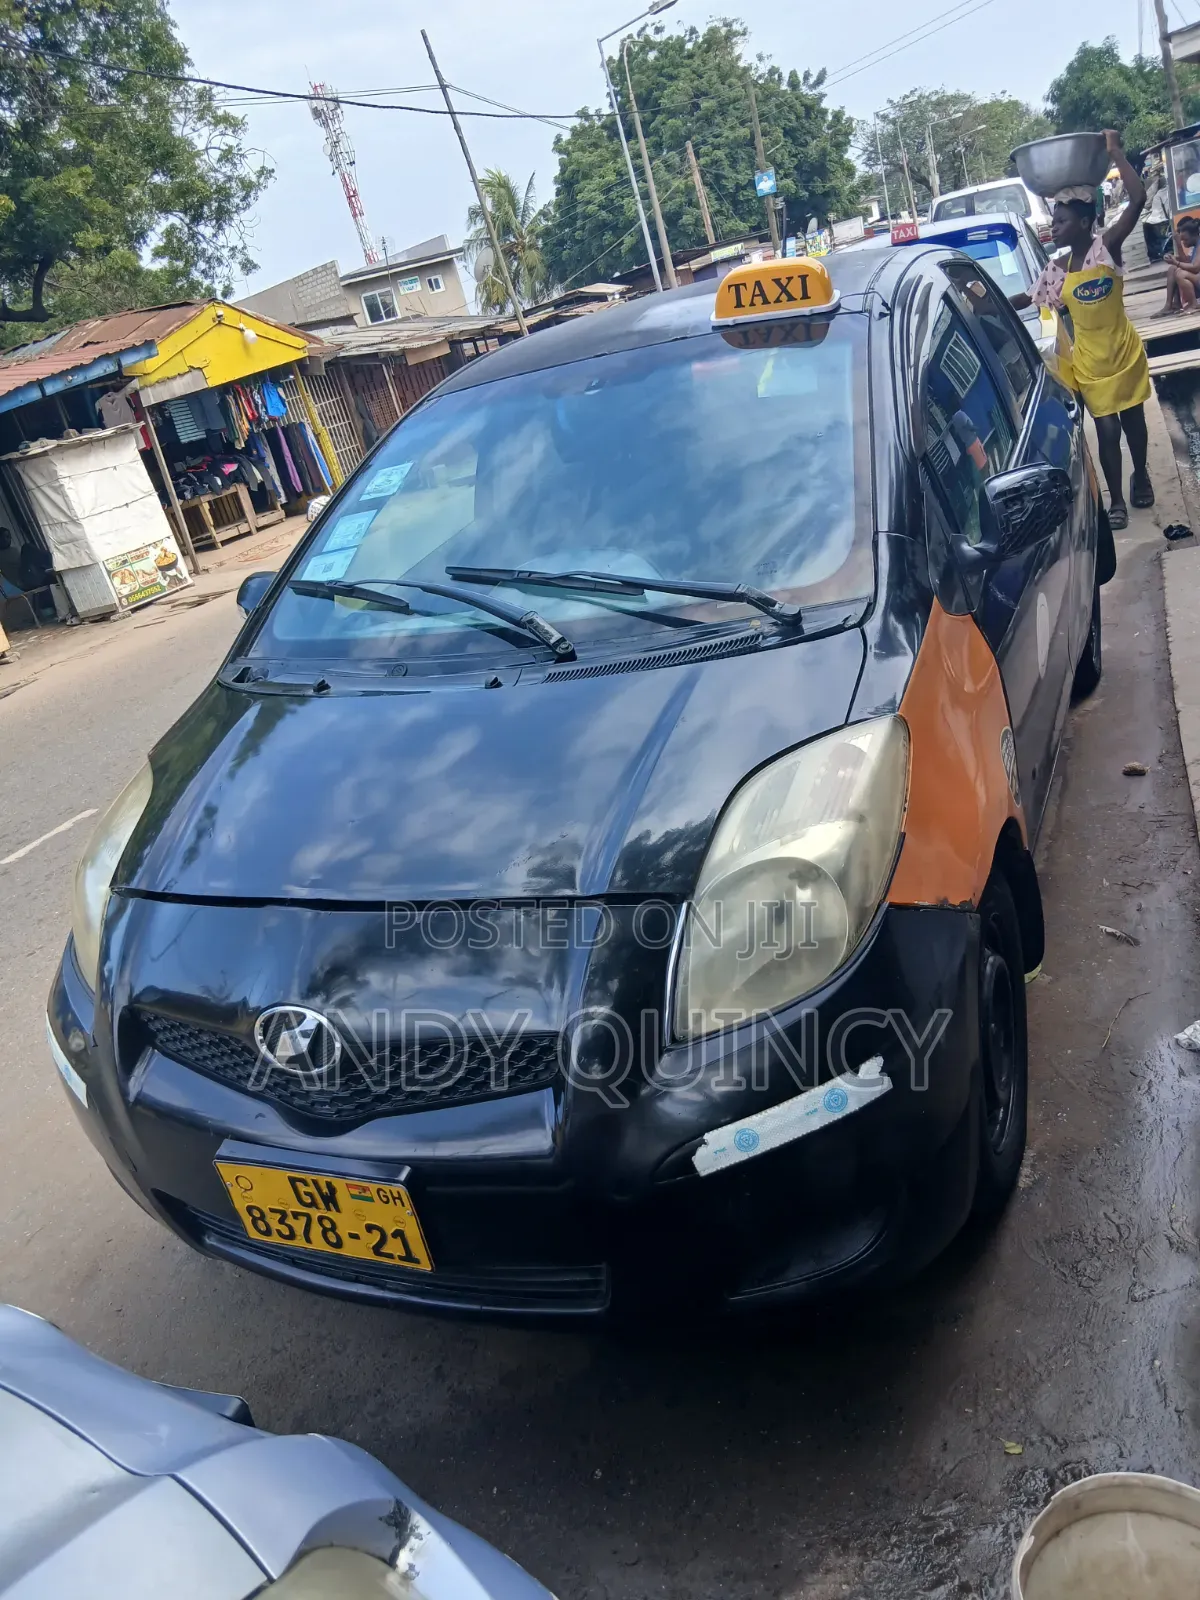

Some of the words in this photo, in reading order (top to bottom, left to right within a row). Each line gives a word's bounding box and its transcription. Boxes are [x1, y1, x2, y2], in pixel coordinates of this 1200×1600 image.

[892, 226, 917, 240] TAXI
[727, 274, 812, 309] TAXI
[287, 1174, 341, 1214] GW
[376, 1187, 406, 1208] GH
[245, 1204, 421, 1265] 8378-21
